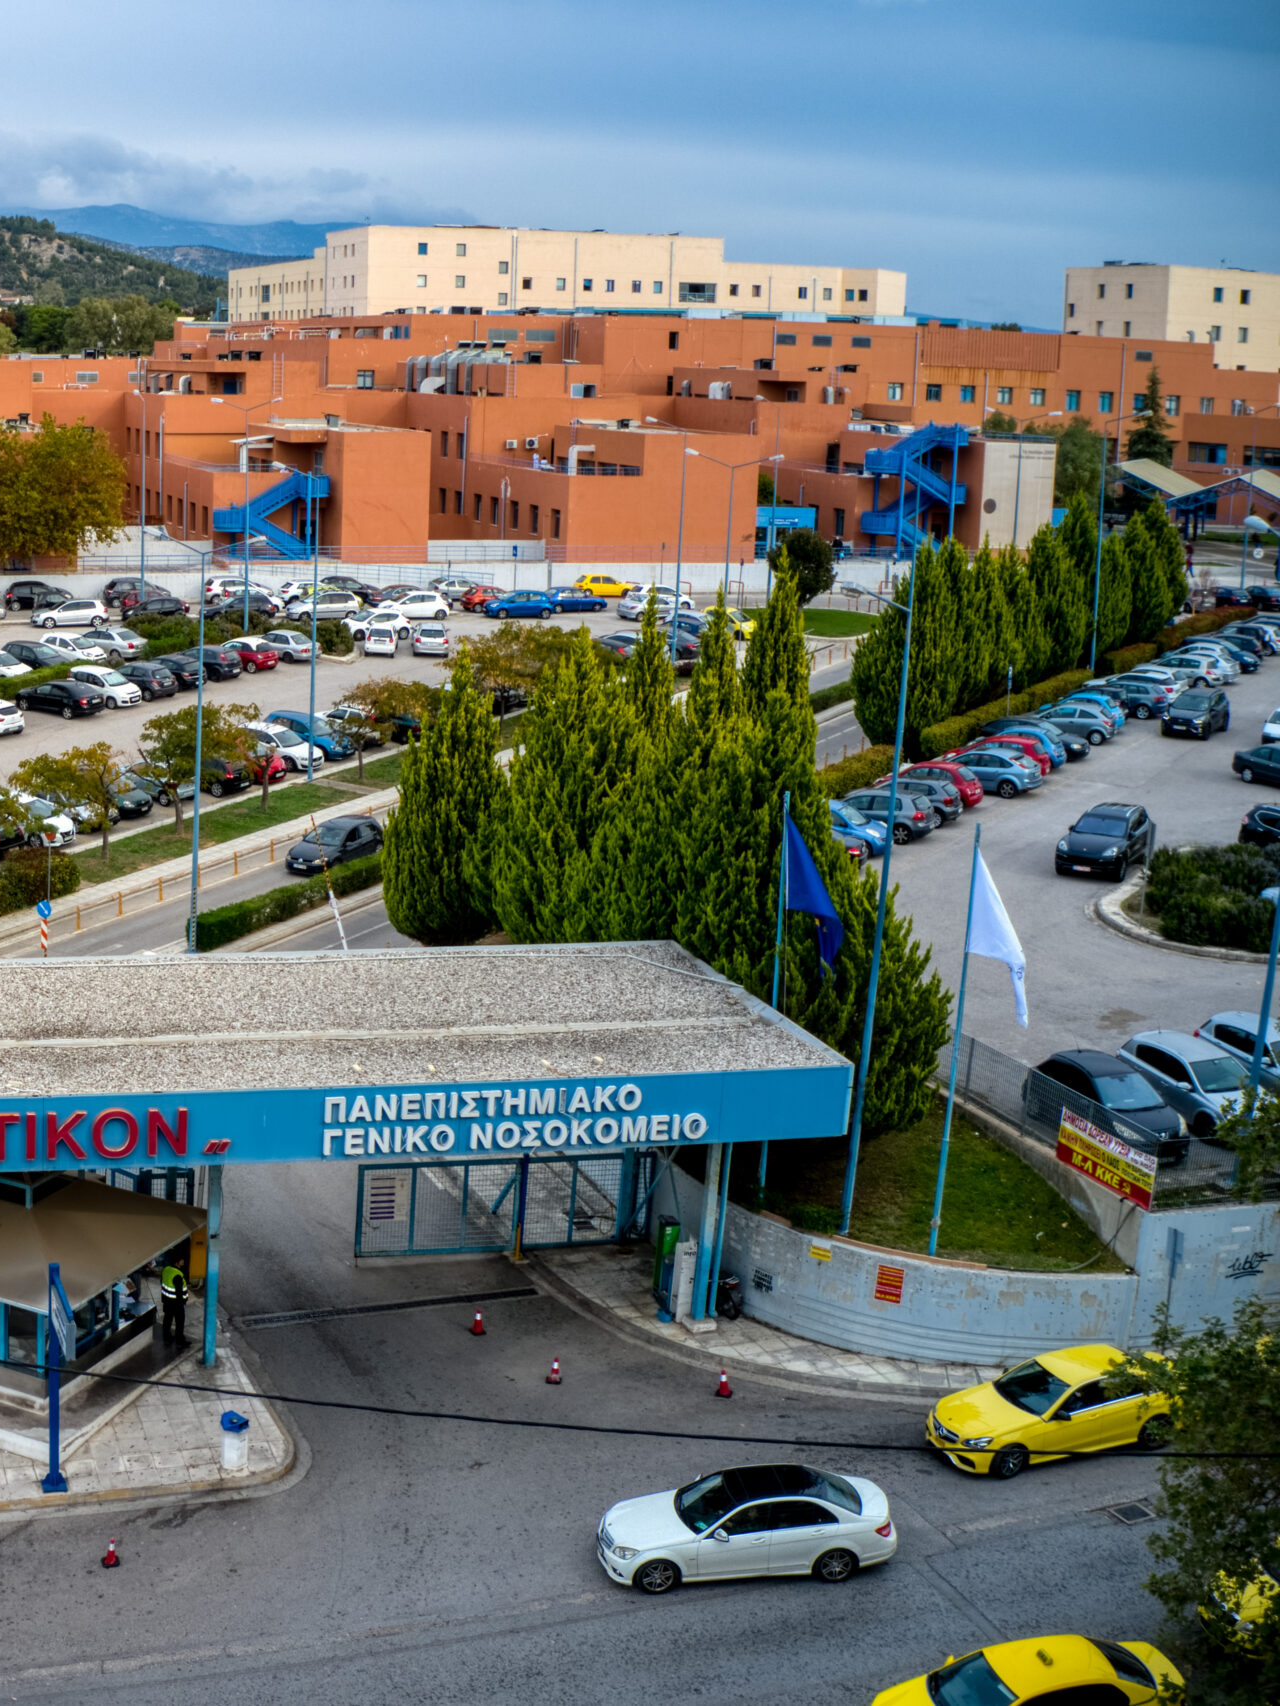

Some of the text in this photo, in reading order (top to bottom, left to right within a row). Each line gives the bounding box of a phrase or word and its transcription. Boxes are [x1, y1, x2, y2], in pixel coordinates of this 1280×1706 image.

[324, 1084, 642, 1123] ΠΑΝΕΠΙΣΤΗΜΙΑΚΟ
[322, 1112, 708, 1156] ΓΕΝΙΚΟ ΝΟΣΟΚΟΜΕΙΟ
[1095, 1163, 1119, 1189] ΚΚΕ
